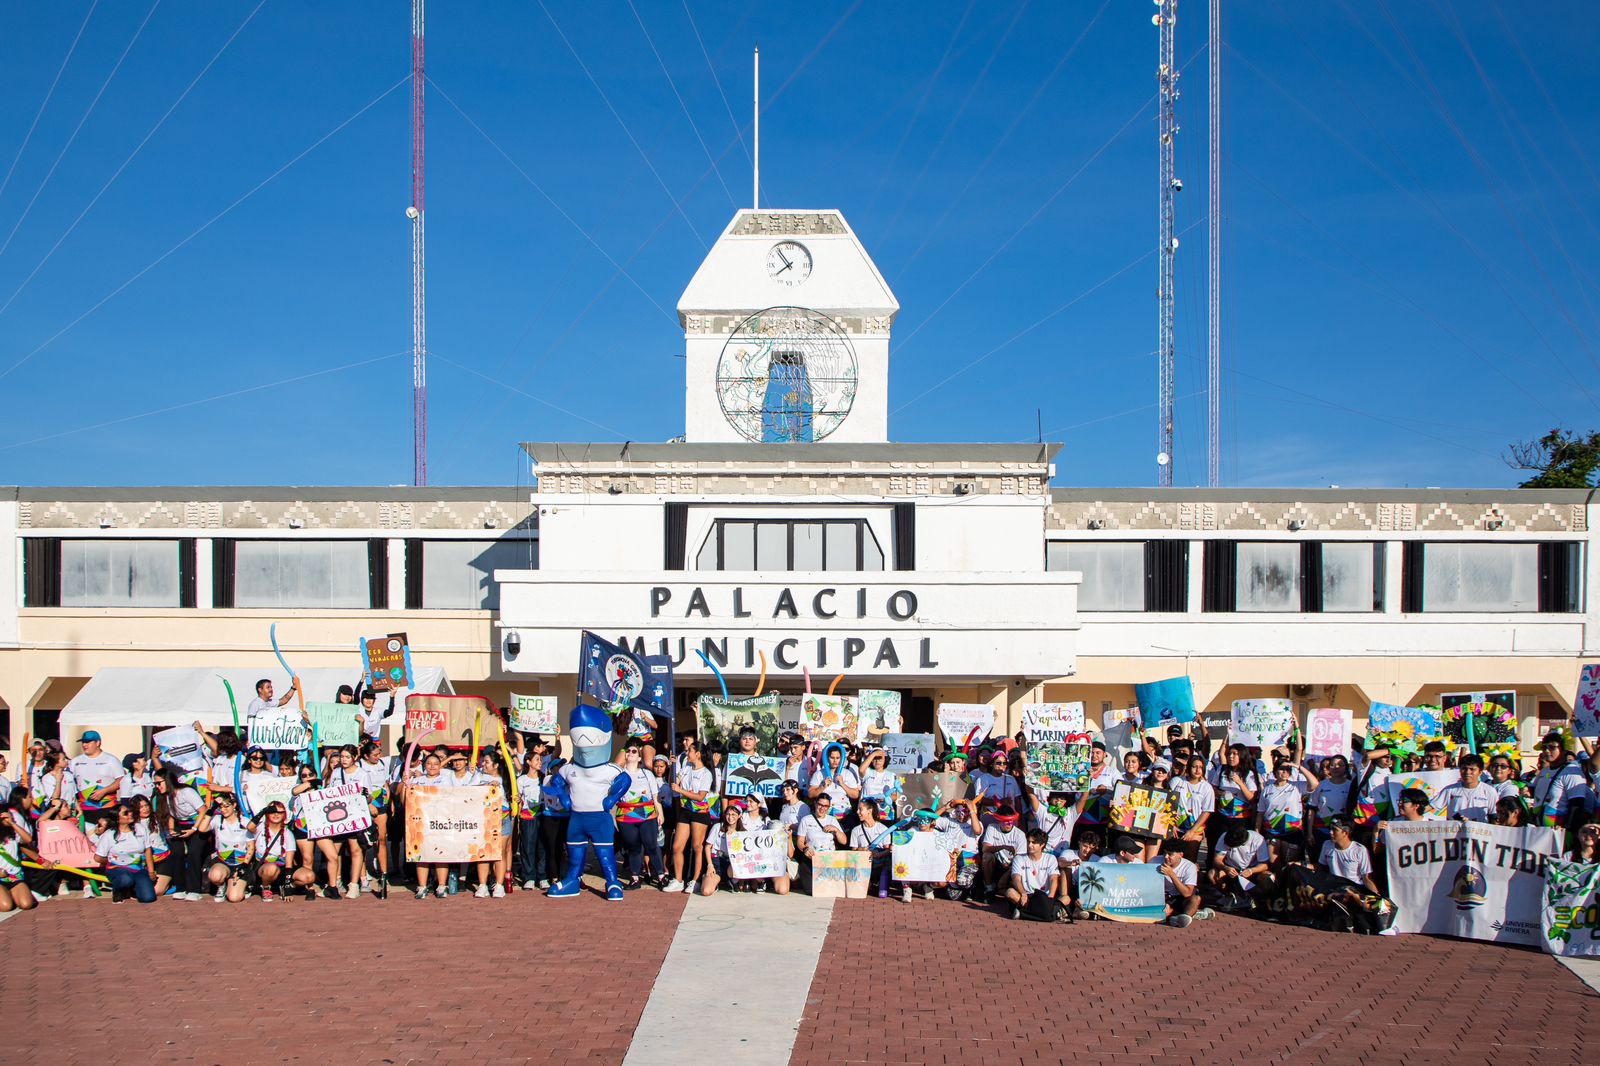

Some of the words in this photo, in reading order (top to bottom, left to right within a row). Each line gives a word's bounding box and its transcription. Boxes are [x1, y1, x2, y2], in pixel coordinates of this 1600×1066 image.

[650, 586, 919, 620] PALACIO
[617, 635, 939, 669] MUNICIPAL
[518, 697, 543, 711] ECO
[700, 695, 713, 704] LOS
[248, 714, 308, 748] Turisteam
[410, 719, 436, 730] VERDE
[429, 819, 478, 833] Bioabejitas
[1397, 837, 1489, 868] GOLDEN
[1107, 887, 1140, 897] MARK
[1101, 897, 1144, 907] RIVIERA
[1504, 927, 1530, 935] RIVIERA
